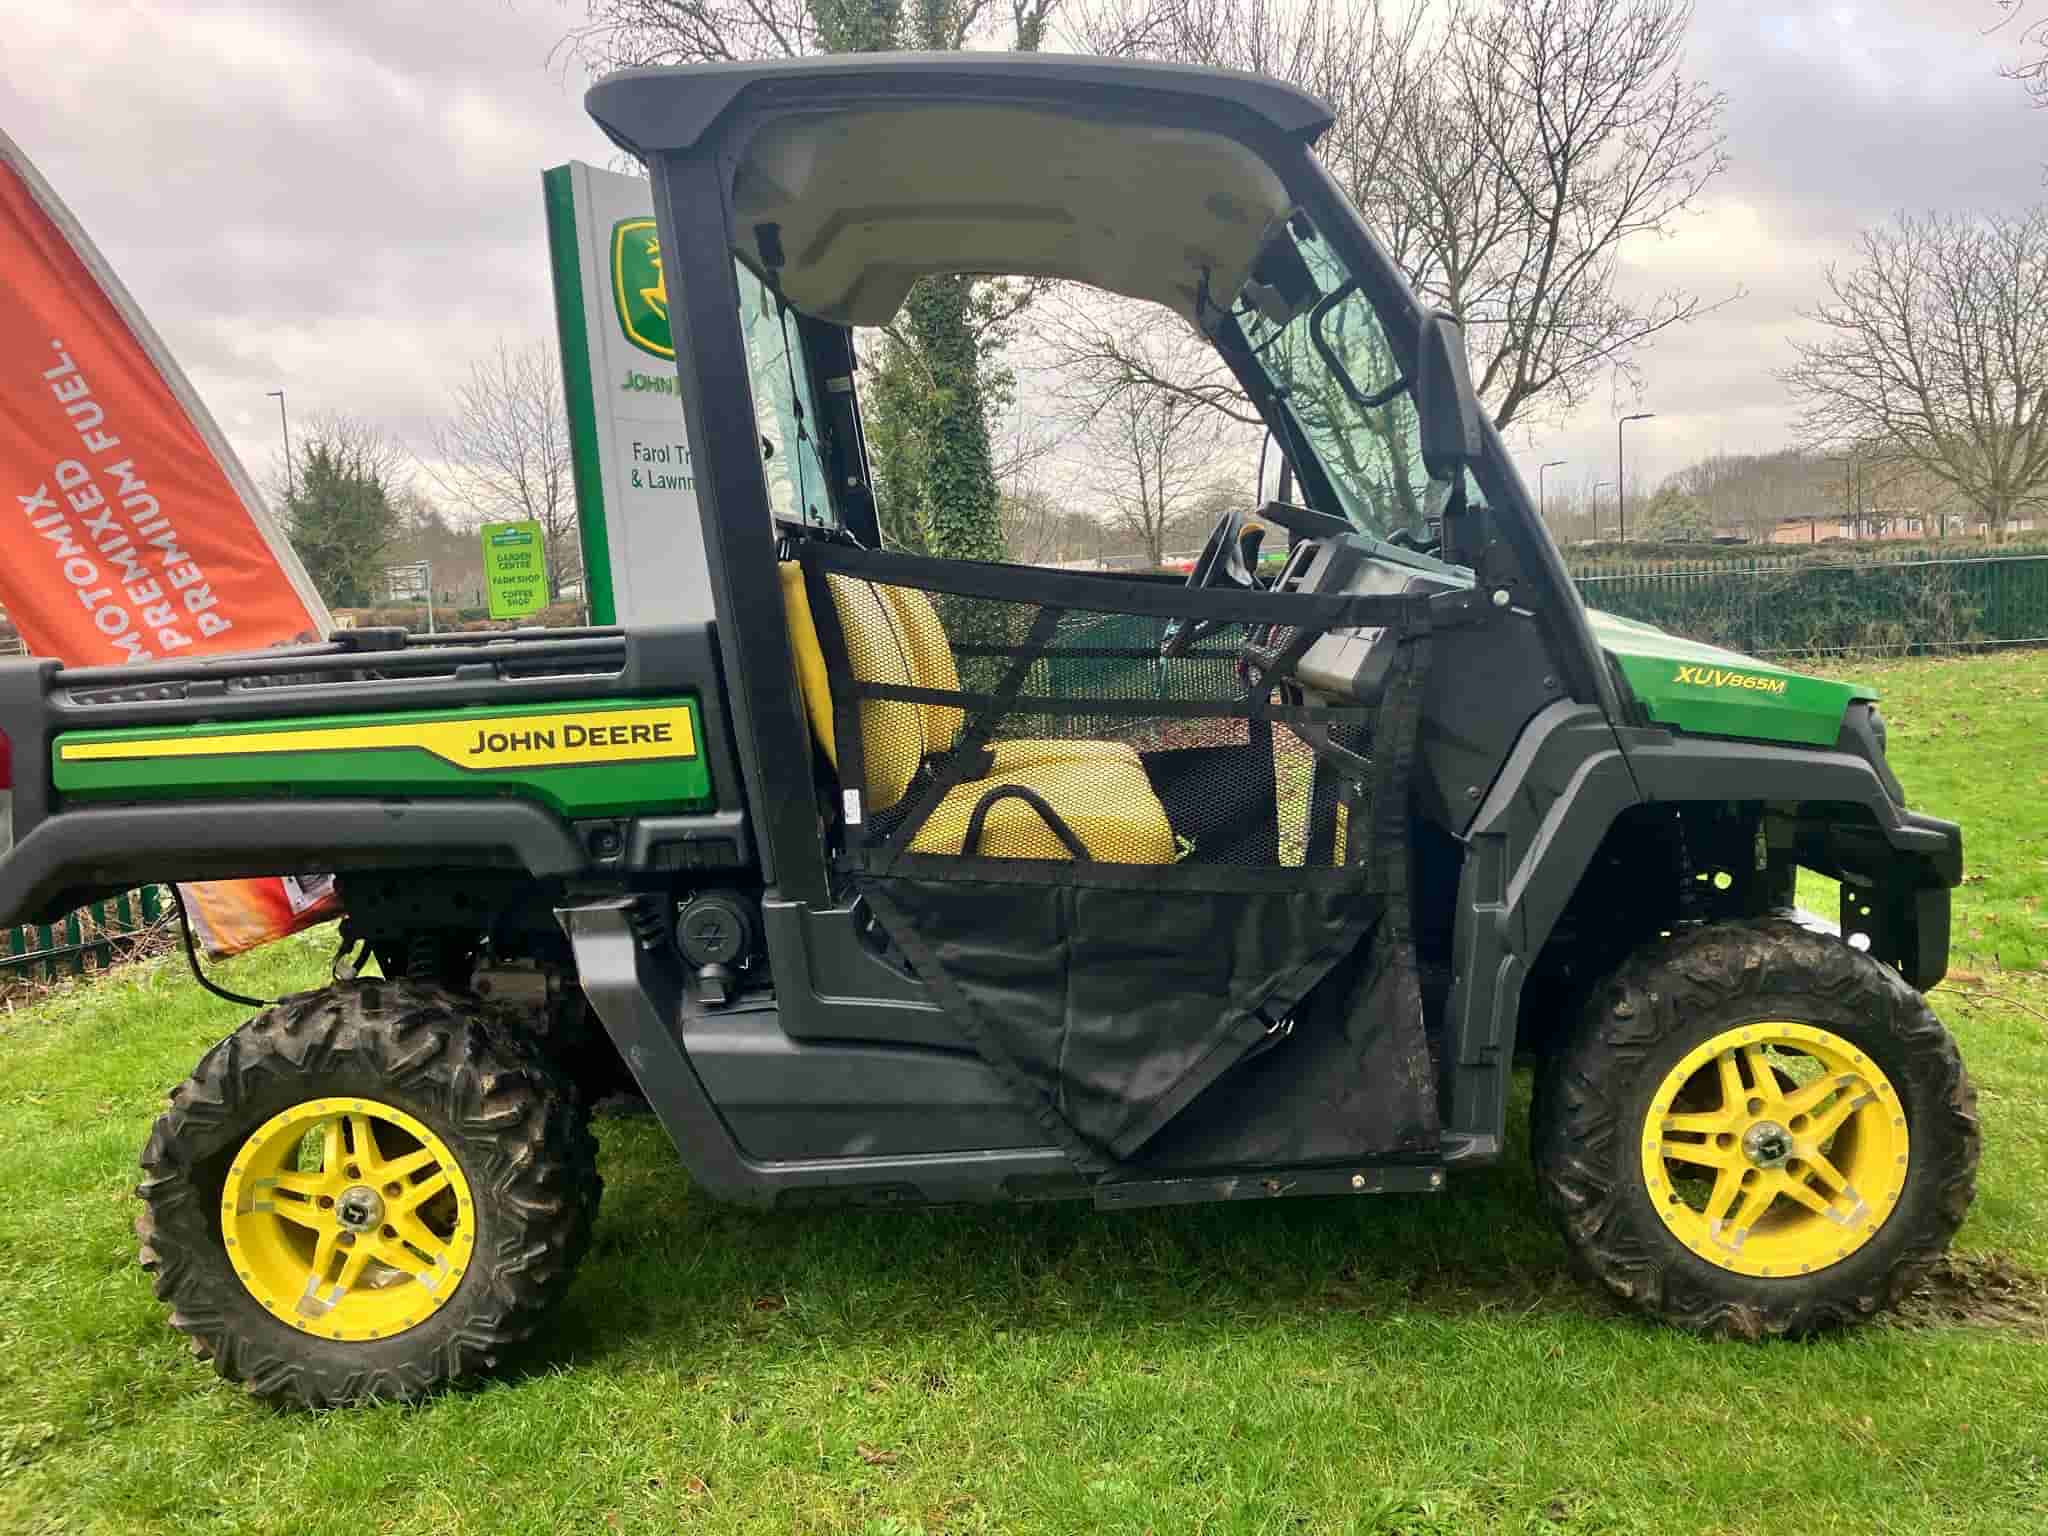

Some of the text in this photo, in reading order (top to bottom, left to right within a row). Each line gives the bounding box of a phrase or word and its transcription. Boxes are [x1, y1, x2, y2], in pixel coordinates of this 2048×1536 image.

[632, 442, 670, 463] Farol
[42, 338, 232, 637] PREMIUM FUEL.
[632, 468, 643, 488] &
[55, 459, 192, 650] PREMIXED
[16, 484, 152, 663] MOTOMIX
[1672, 666, 1785, 694] XUV865M
[469, 722, 673, 755] JOHN DEERE
